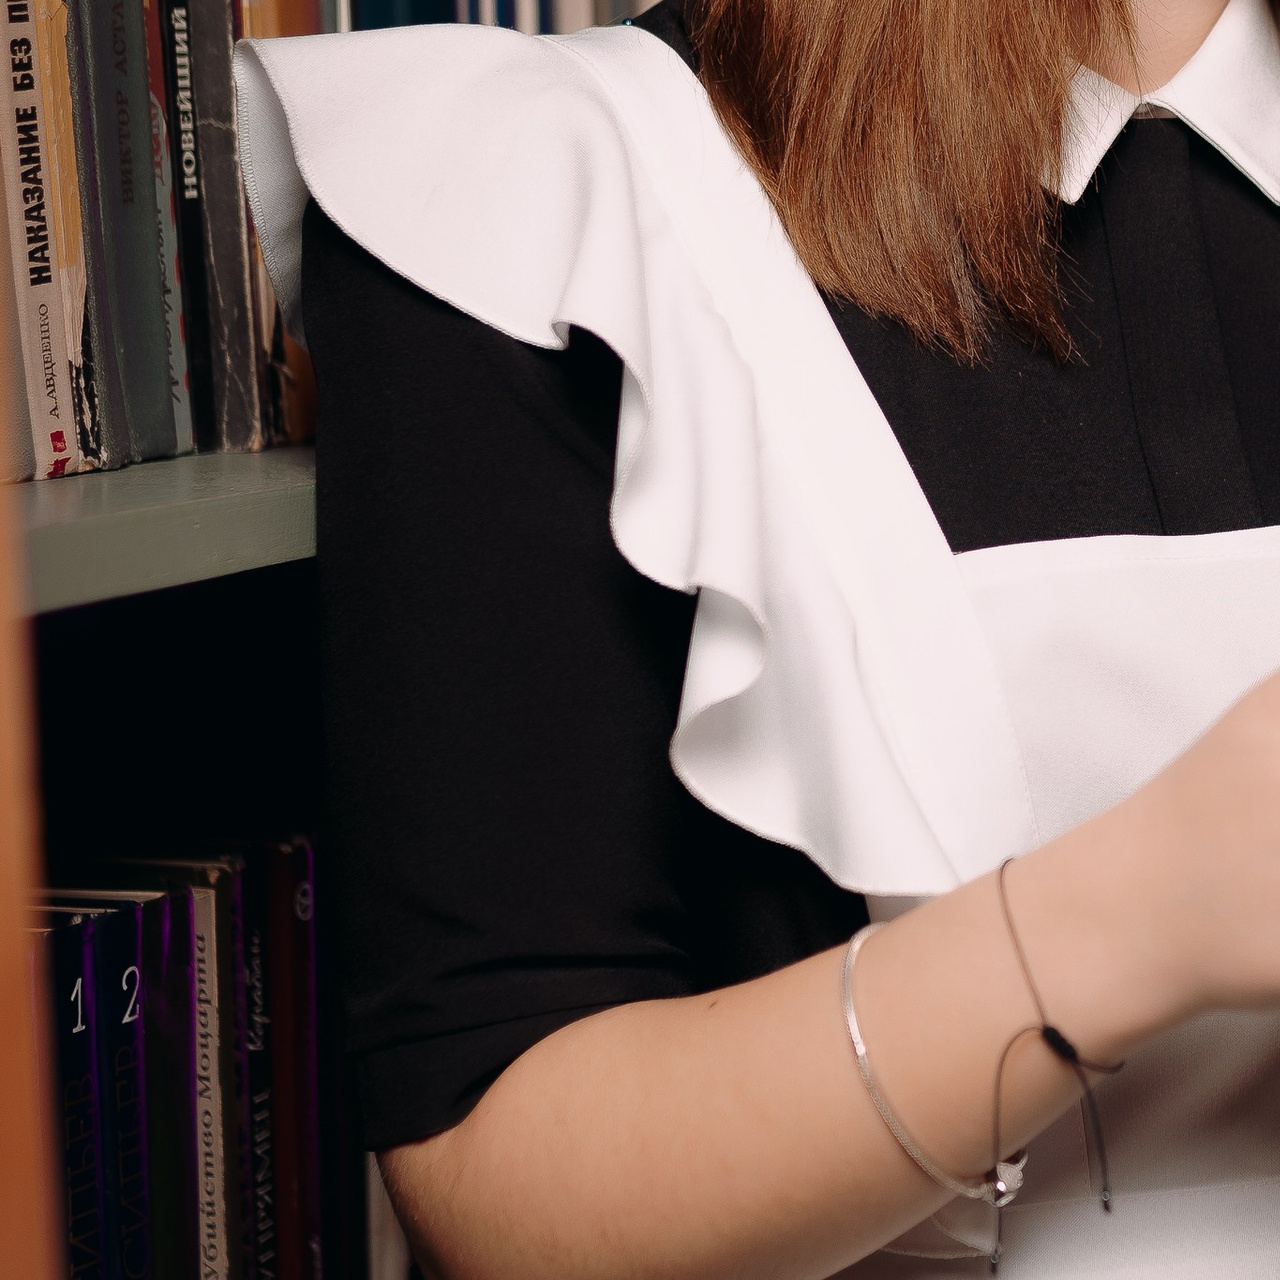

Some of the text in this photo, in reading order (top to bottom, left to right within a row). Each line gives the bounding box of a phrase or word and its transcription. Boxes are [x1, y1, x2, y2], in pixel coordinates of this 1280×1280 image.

[9, 36, 36, 92] БЕЗ
[171, 6, 198, 200] НОВЕЙШИЙ
[14, 105, 52, 287] НАКАЗАНИЕ
[114, 88, 134, 205] ВИКТОР
[37, 303, 59, 419] А.АВДЕЕНКО
[70, 977, 86, 1034] 1
[121, 965, 140, 1025] 2
[196, 933, 220, 1101] Моцарта
[201, 1109, 222, 1280] Убийство
